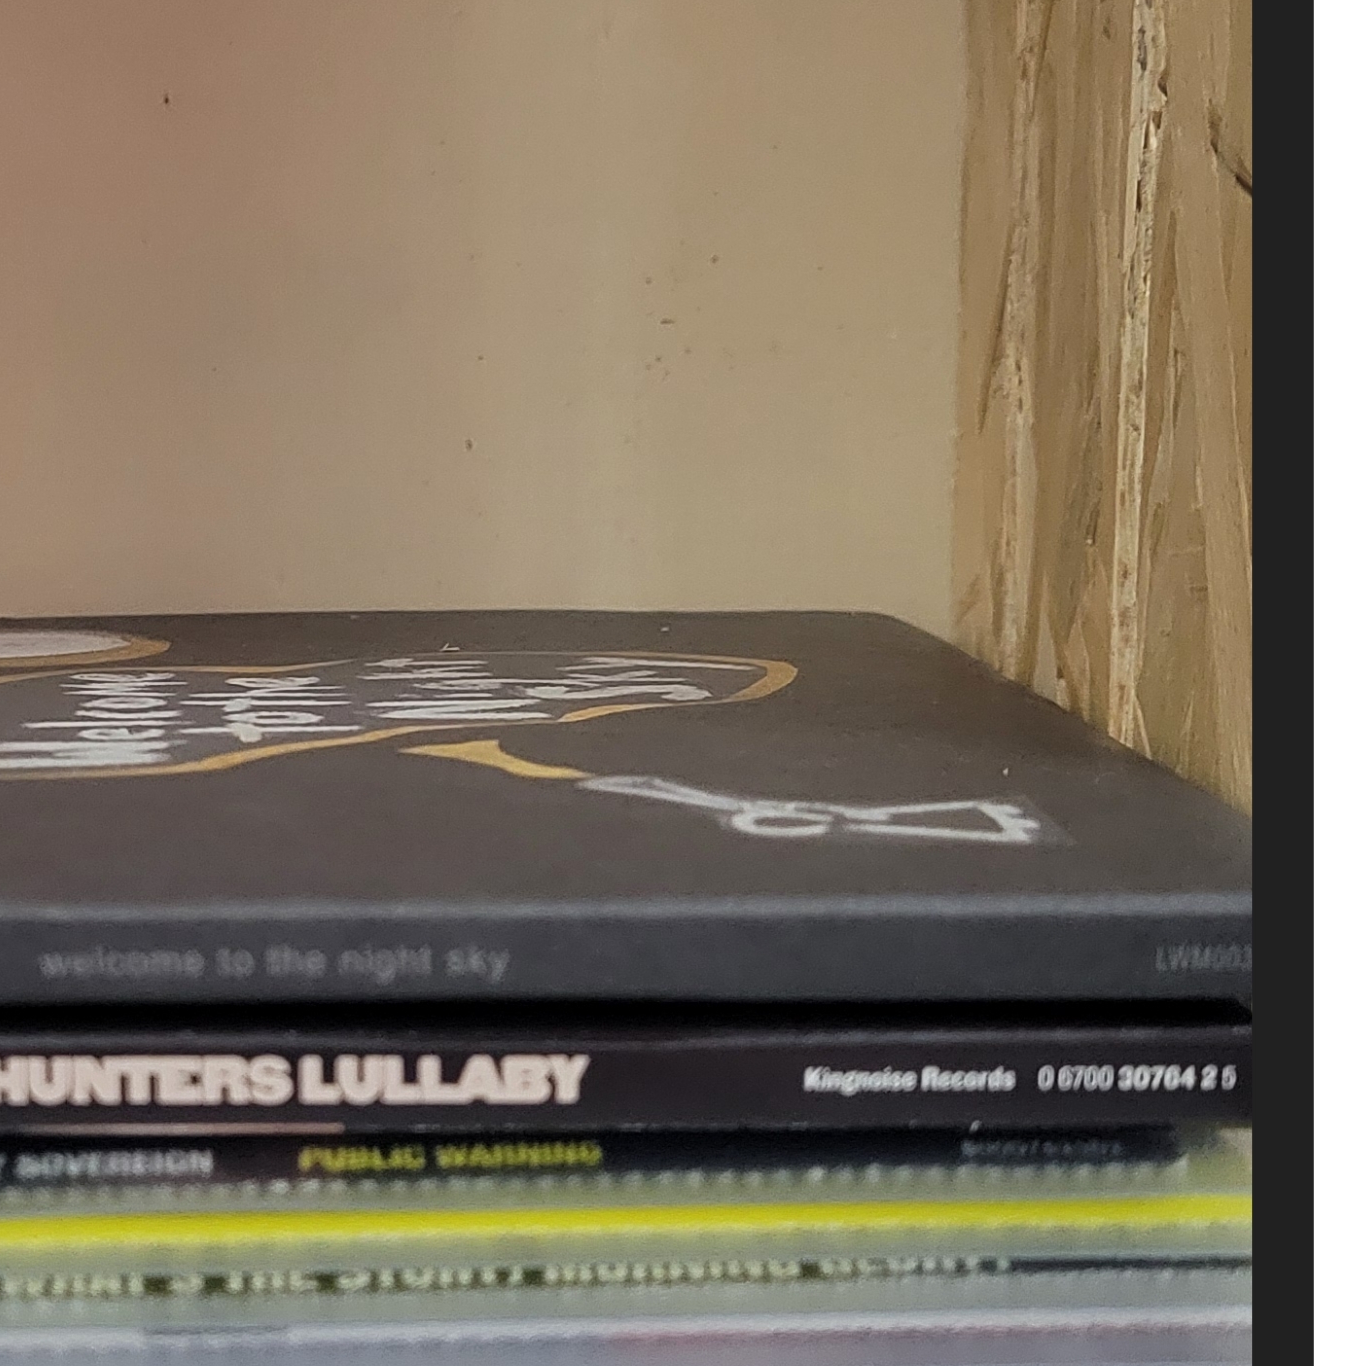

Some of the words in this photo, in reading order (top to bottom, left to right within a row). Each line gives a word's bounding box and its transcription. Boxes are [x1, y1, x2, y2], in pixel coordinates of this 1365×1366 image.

[214, 948, 256, 977] to
[299, 1054, 590, 1107] LULLABY
[802, 1065, 918, 1097] Kingnoise
[920, 1065, 1017, 1093] Records
[1037, 1064, 1054, 1092] 0
[1057, 1064, 1115, 1093] 6700
[1116, 1064, 1196, 1092] 30764
[1200, 1064, 1218, 1091] 2
[1220, 1063, 1237, 1091] 5
[14, 1148, 214, 1180] SOVEREIGN
[298, 1143, 426, 1173] PUBLIC
[435, 1140, 603, 1171] WARNING
